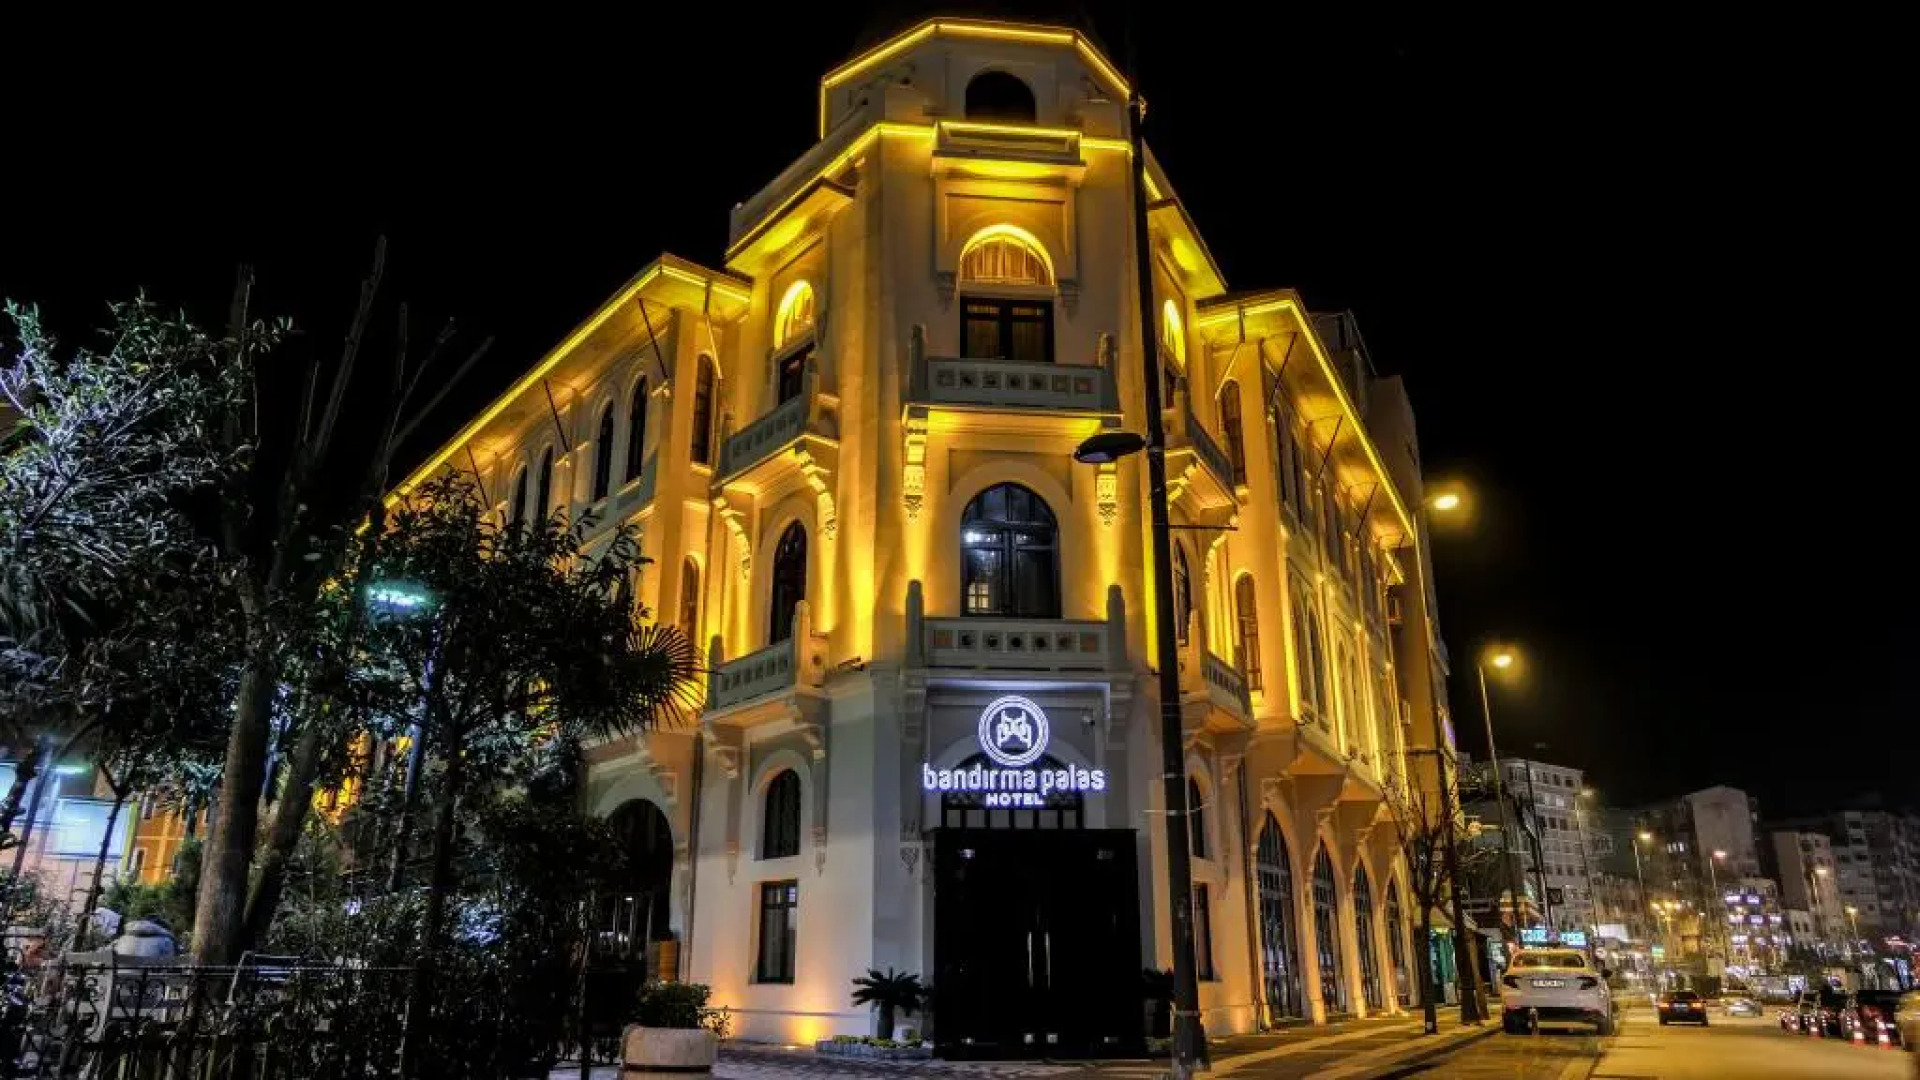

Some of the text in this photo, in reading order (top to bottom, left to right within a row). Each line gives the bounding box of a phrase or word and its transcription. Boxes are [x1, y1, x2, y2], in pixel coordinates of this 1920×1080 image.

[923, 763, 1106, 795] bandırma palas
[985, 793, 1045, 806] HOTEL
